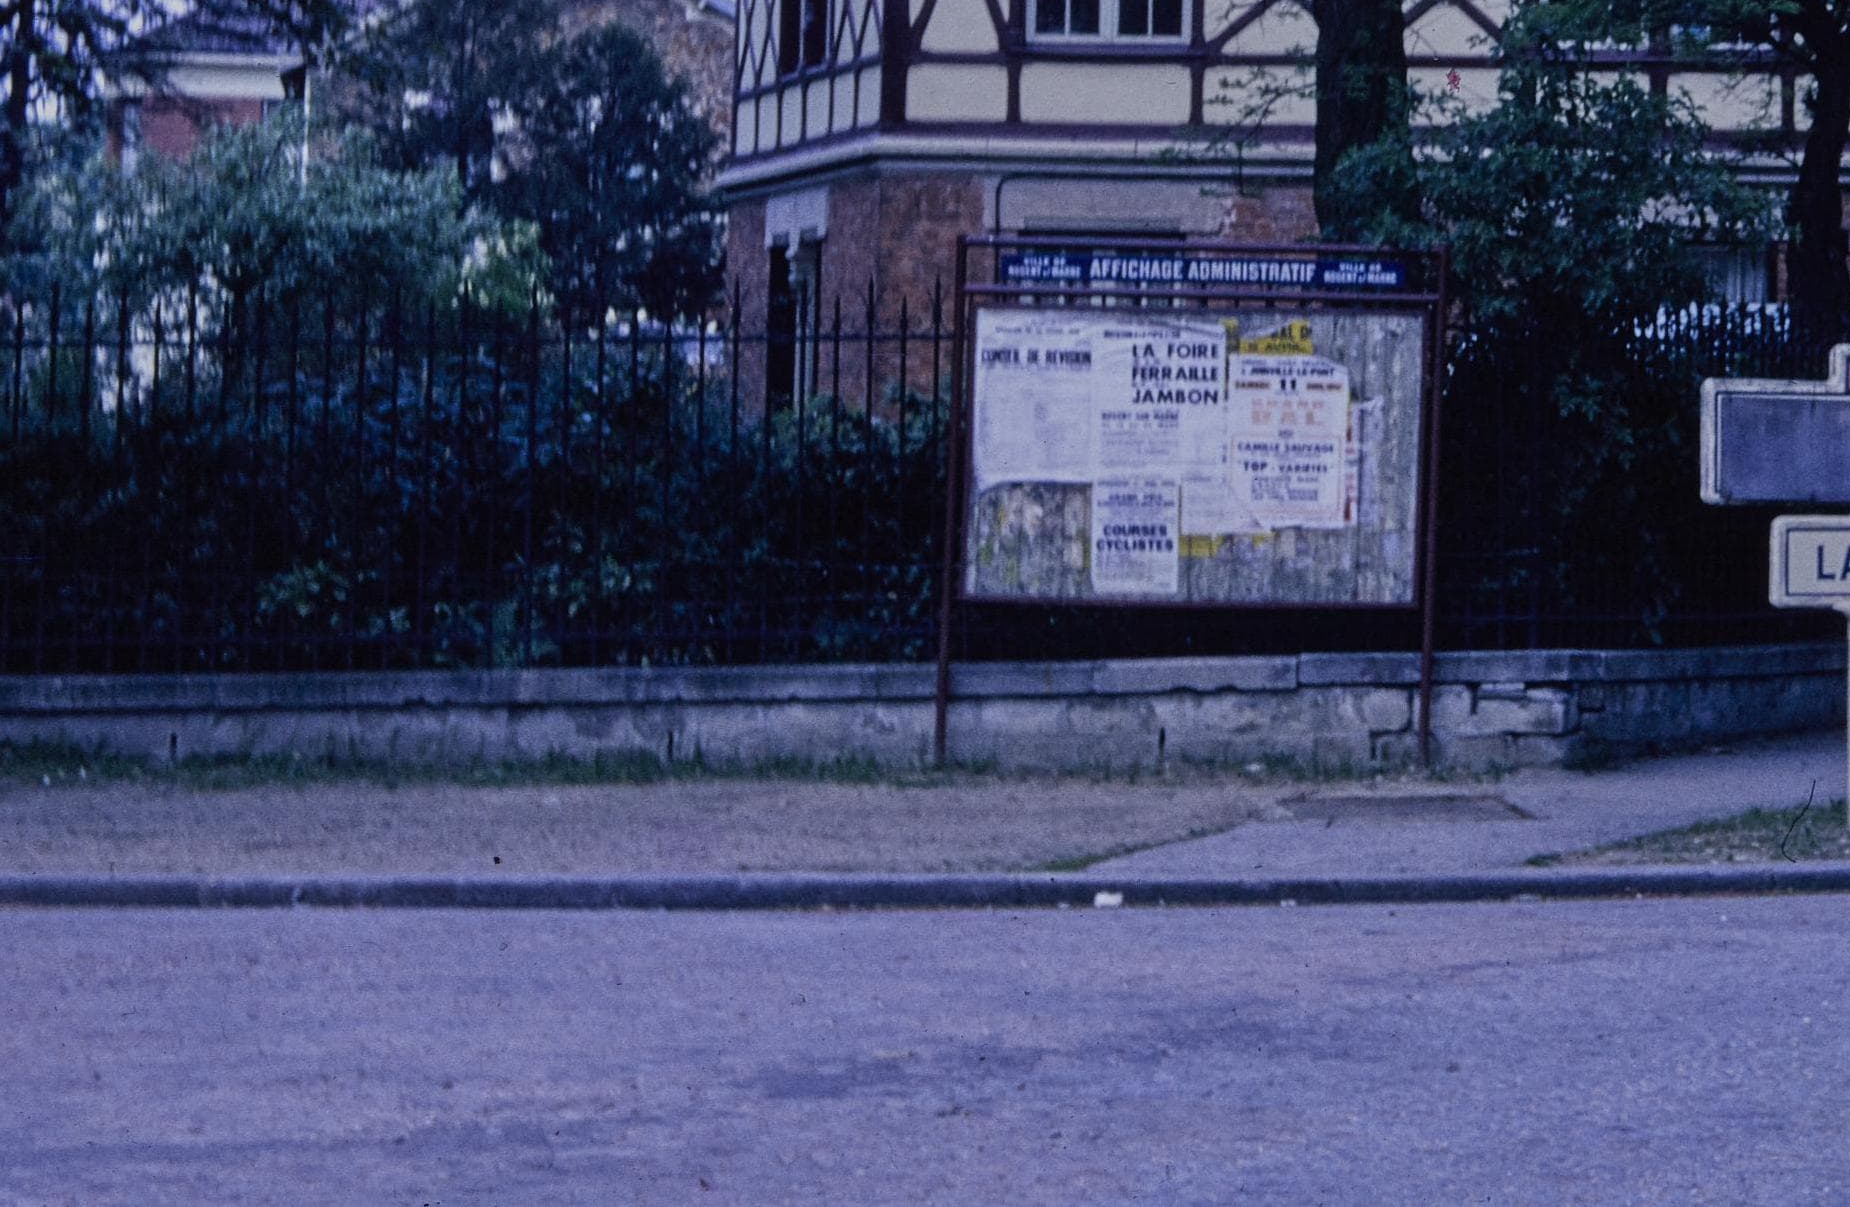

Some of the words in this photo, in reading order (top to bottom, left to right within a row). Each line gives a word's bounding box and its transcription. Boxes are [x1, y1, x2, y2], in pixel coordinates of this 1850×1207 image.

[1090, 258, 1183, 280] AFFICHAGE
[1188, 261, 1316, 282] ADMINISTRATIF
[1132, 343, 1155, 358] LA
[1167, 343, 1218, 359] FOIRE
[1132, 366, 1218, 382] FERRAILLE
[1132, 389, 1219, 405] JAMBON
[1103, 524, 1168, 537] COURSES
[1096, 538, 1174, 552] CYCLISTES
